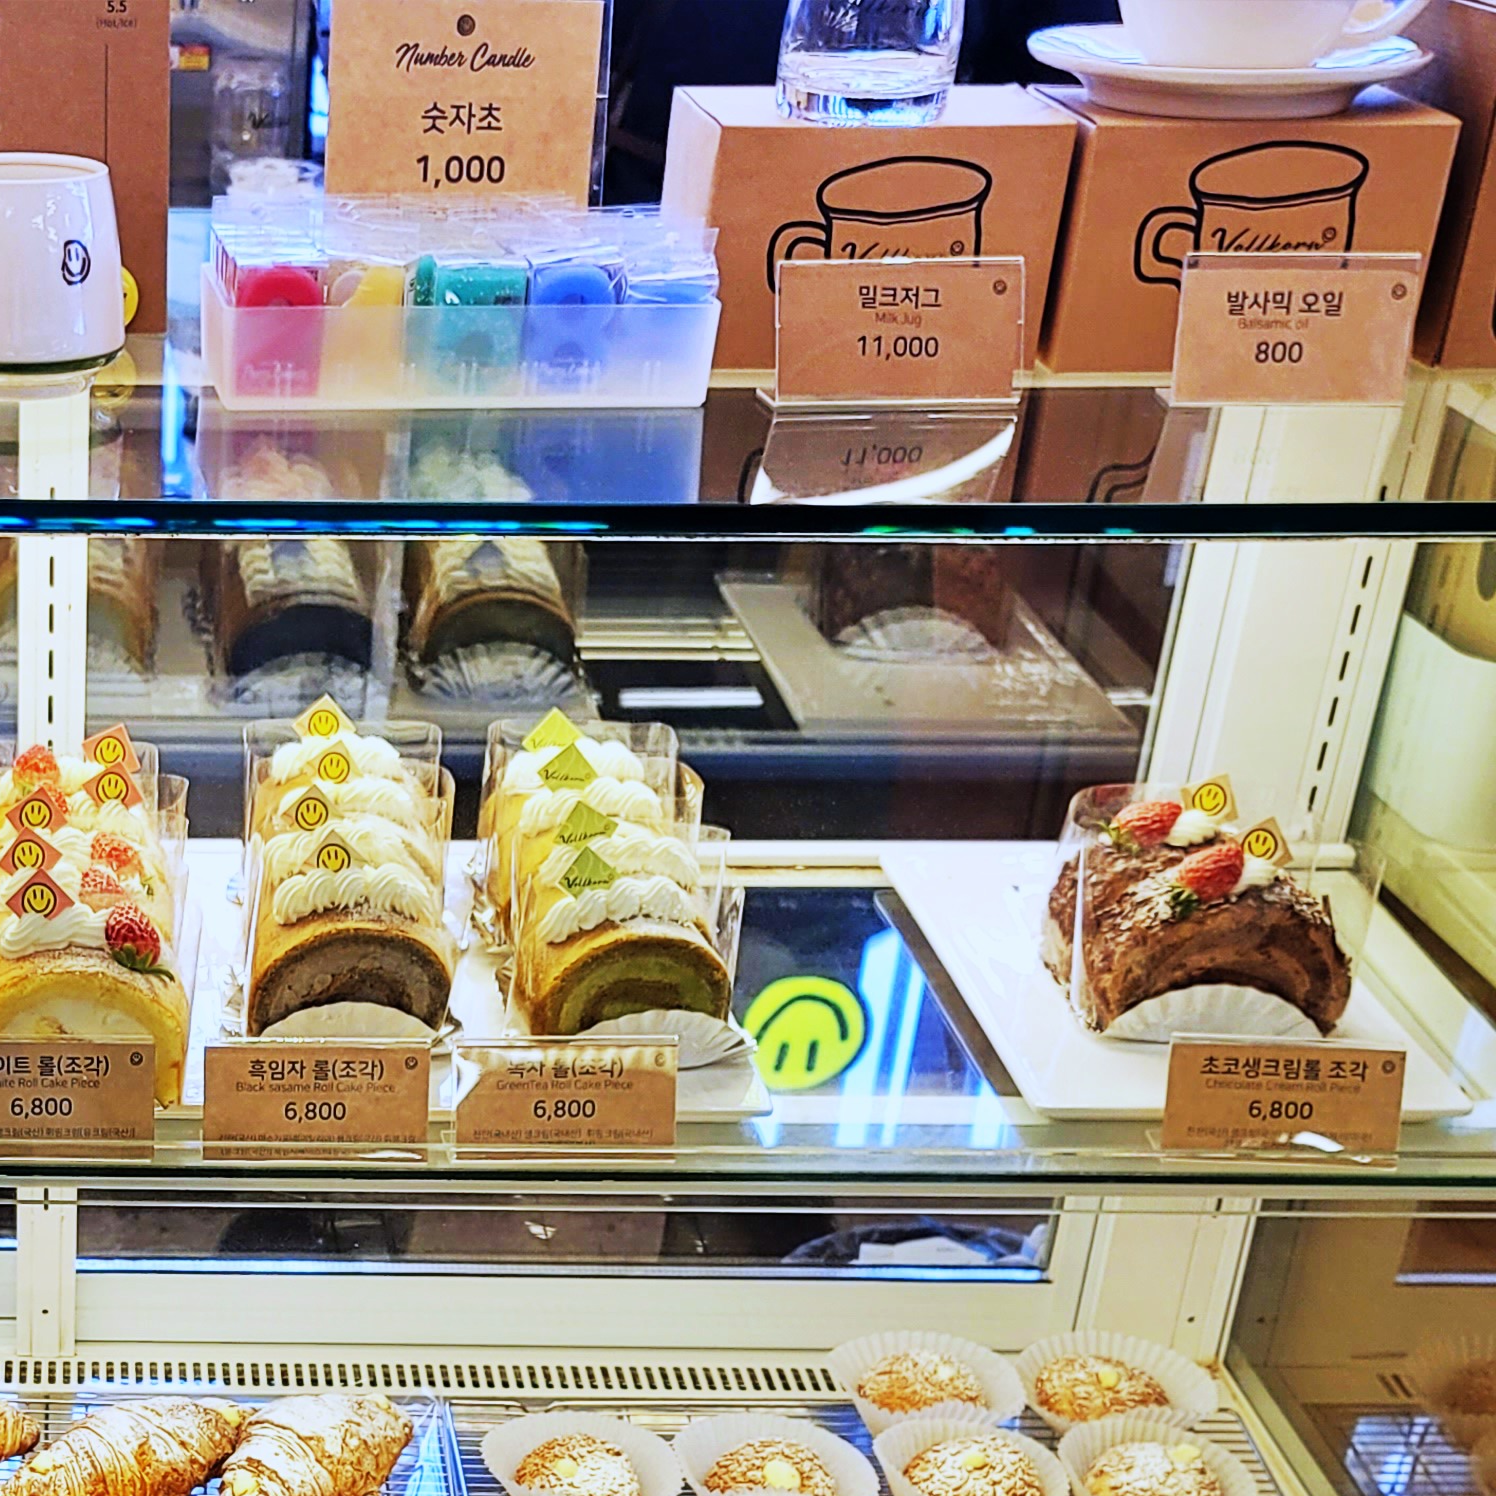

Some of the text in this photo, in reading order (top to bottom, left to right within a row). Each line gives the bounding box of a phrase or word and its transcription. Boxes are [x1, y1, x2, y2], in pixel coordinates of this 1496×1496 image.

[107, 0, 127, 13] 5.5
[396, 42, 535, 73] Number Candle
[421, 101, 502, 135] 숫자초
[416, 155, 505, 189] 1,000
[859, 284, 942, 310] 밀크저그
[1227, 290, 1344, 317] 발사믹 오일
[875, 312, 923, 328] Milk Jug
[1238, 318, 1309, 330] Balsamic oil
[857, 335, 939, 361] 11,000
[1255, 341, 1303, 363] 800
[37, 1055, 110, 1077] 롤(조각)
[248, 1059, 384, 1081] 흑임자 롤(조각)
[1200, 1056, 1369, 1082] 초코생크림롤 조각
[18, 1077, 38, 1088] Roll
[41, 1077, 68, 1088] Cake
[71, 1077, 101, 1088] Piece
[236, 1082, 265, 1092] Black
[313, 1082, 334, 1092] Roll
[336, 1082, 363, 1092] Cake
[366, 1082, 396, 1093] Piece
[551, 1080, 571, 1090] Roll
[574, 1080, 601, 1090] Cake
[604, 1080, 633, 1090] Piece
[1205, 1078, 1361, 1094] Chocolate Cream Roll Piece
[10, 1097, 73, 1119] 6,800
[284, 1102, 347, 1123] 6,800
[533, 1099, 596, 1121] 6,800
[1248, 1100, 1314, 1121] 6,800
